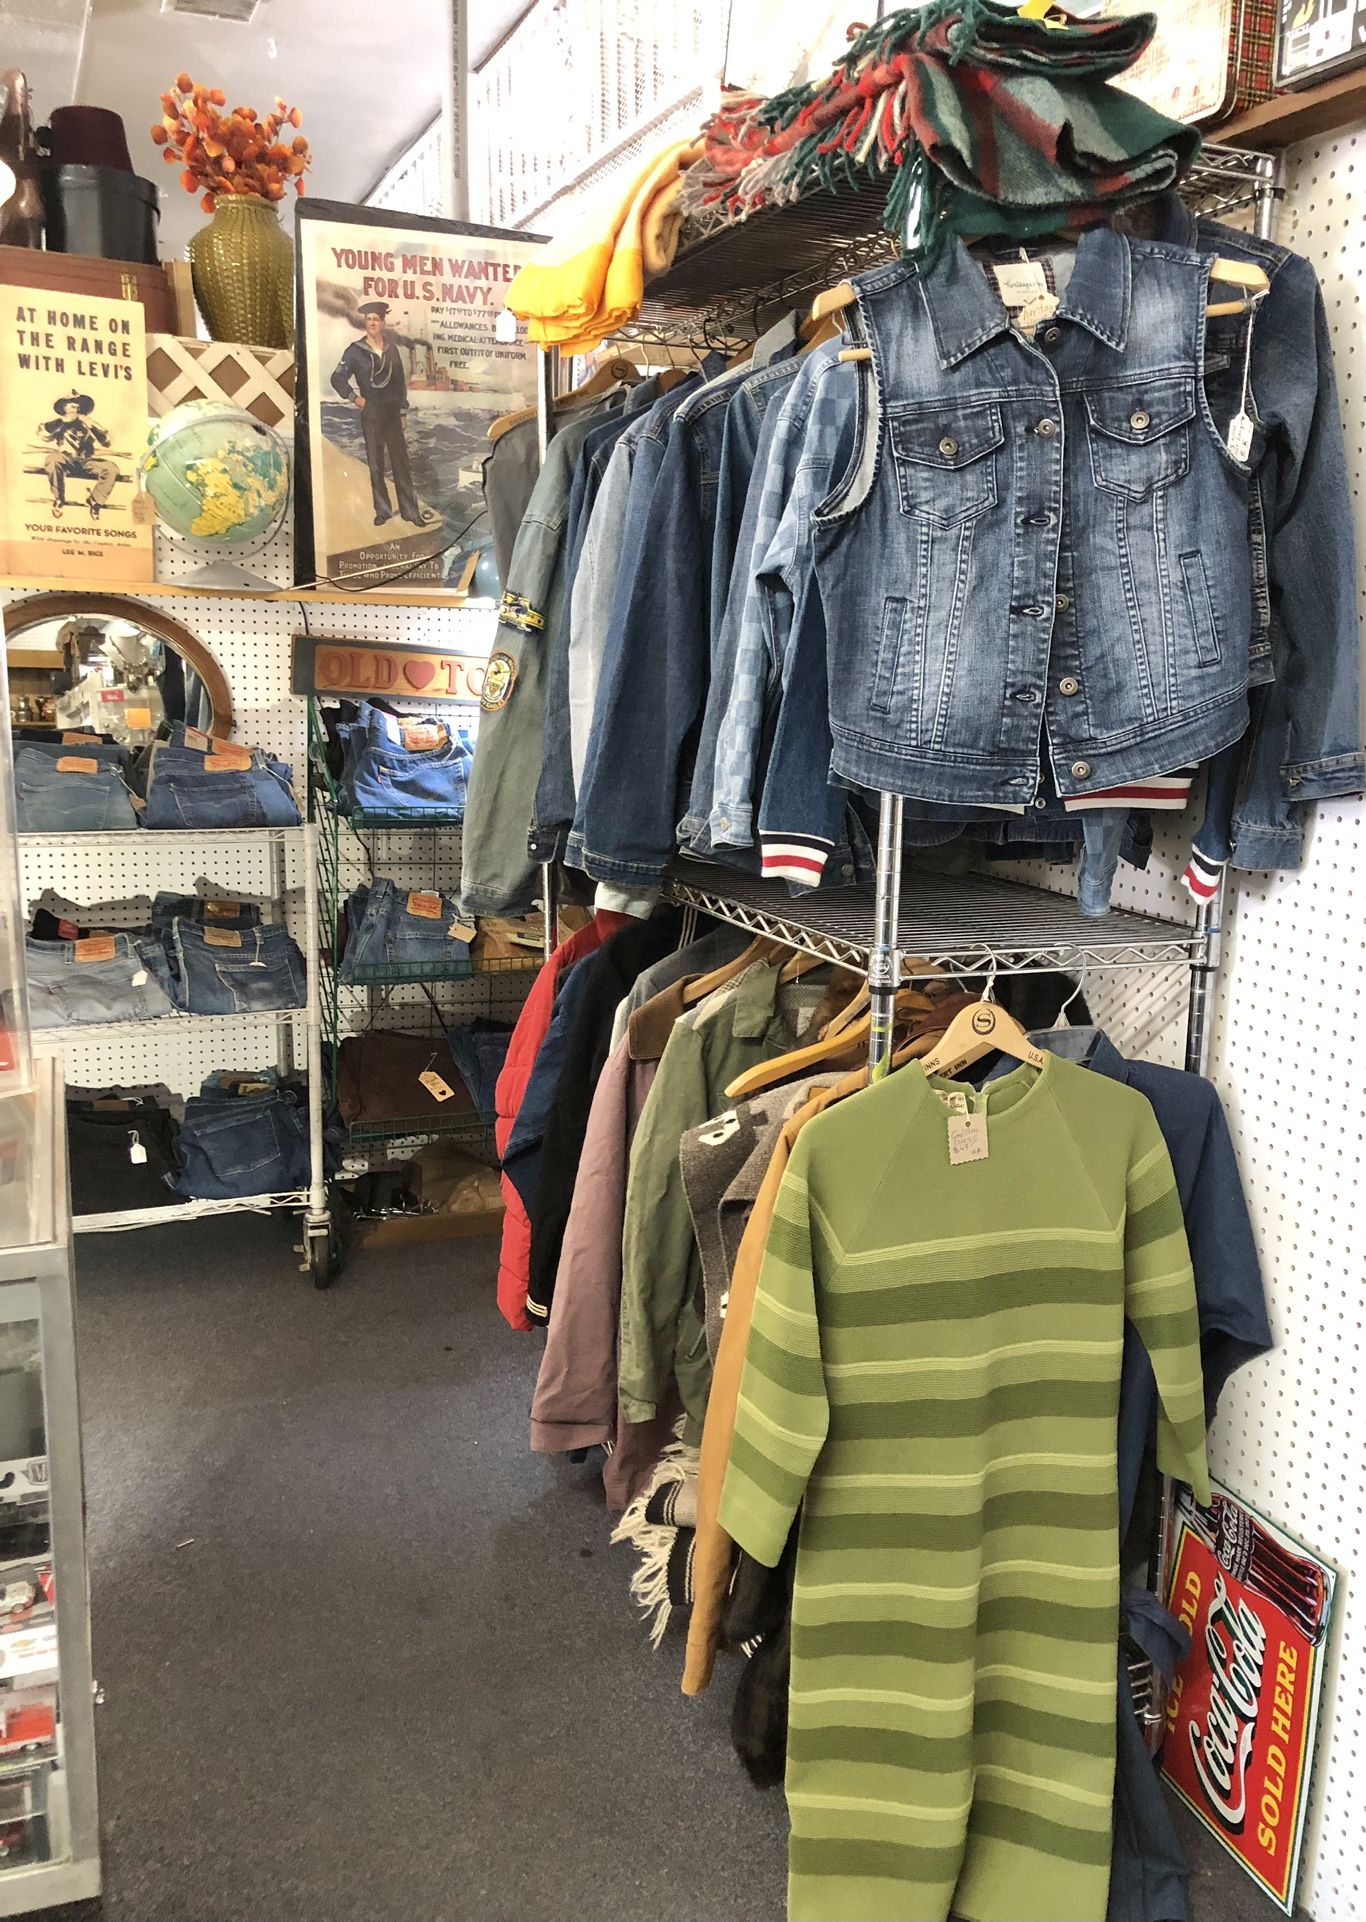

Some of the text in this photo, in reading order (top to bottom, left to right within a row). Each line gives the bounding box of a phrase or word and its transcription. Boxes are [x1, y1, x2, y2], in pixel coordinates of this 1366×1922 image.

[331, 247, 395, 272] YOUNG
[402, 254, 443, 276] MEN
[363, 276, 400, 299] FOR
[441, 283, 494, 306] NAVY.
[16, 305, 130, 335] AT HOME ON
[431, 306, 444, 314] PAY
[16, 330, 131, 358] THE RANGE
[448, 334, 478, 342] MEDICAL
[17, 353, 132, 381] WITH LEVI'S
[437, 346, 526, 360] FIRST OUTFIT OF UNIFORM
[25, 523, 137, 538] YOUR FAVORITE SONGS
[360, 552, 408, 560] OPPORTUNITY
[319, 651, 399, 689] OLD
[924, 1058, 940, 1071] INNS
[954, 1059, 967, 1070] INN
[1179, 1571, 1201, 1637] OLD
[1189, 1570, 1266, 1824] Coca-Cola
[1258, 1641, 1298, 1856] SOLD HERE
